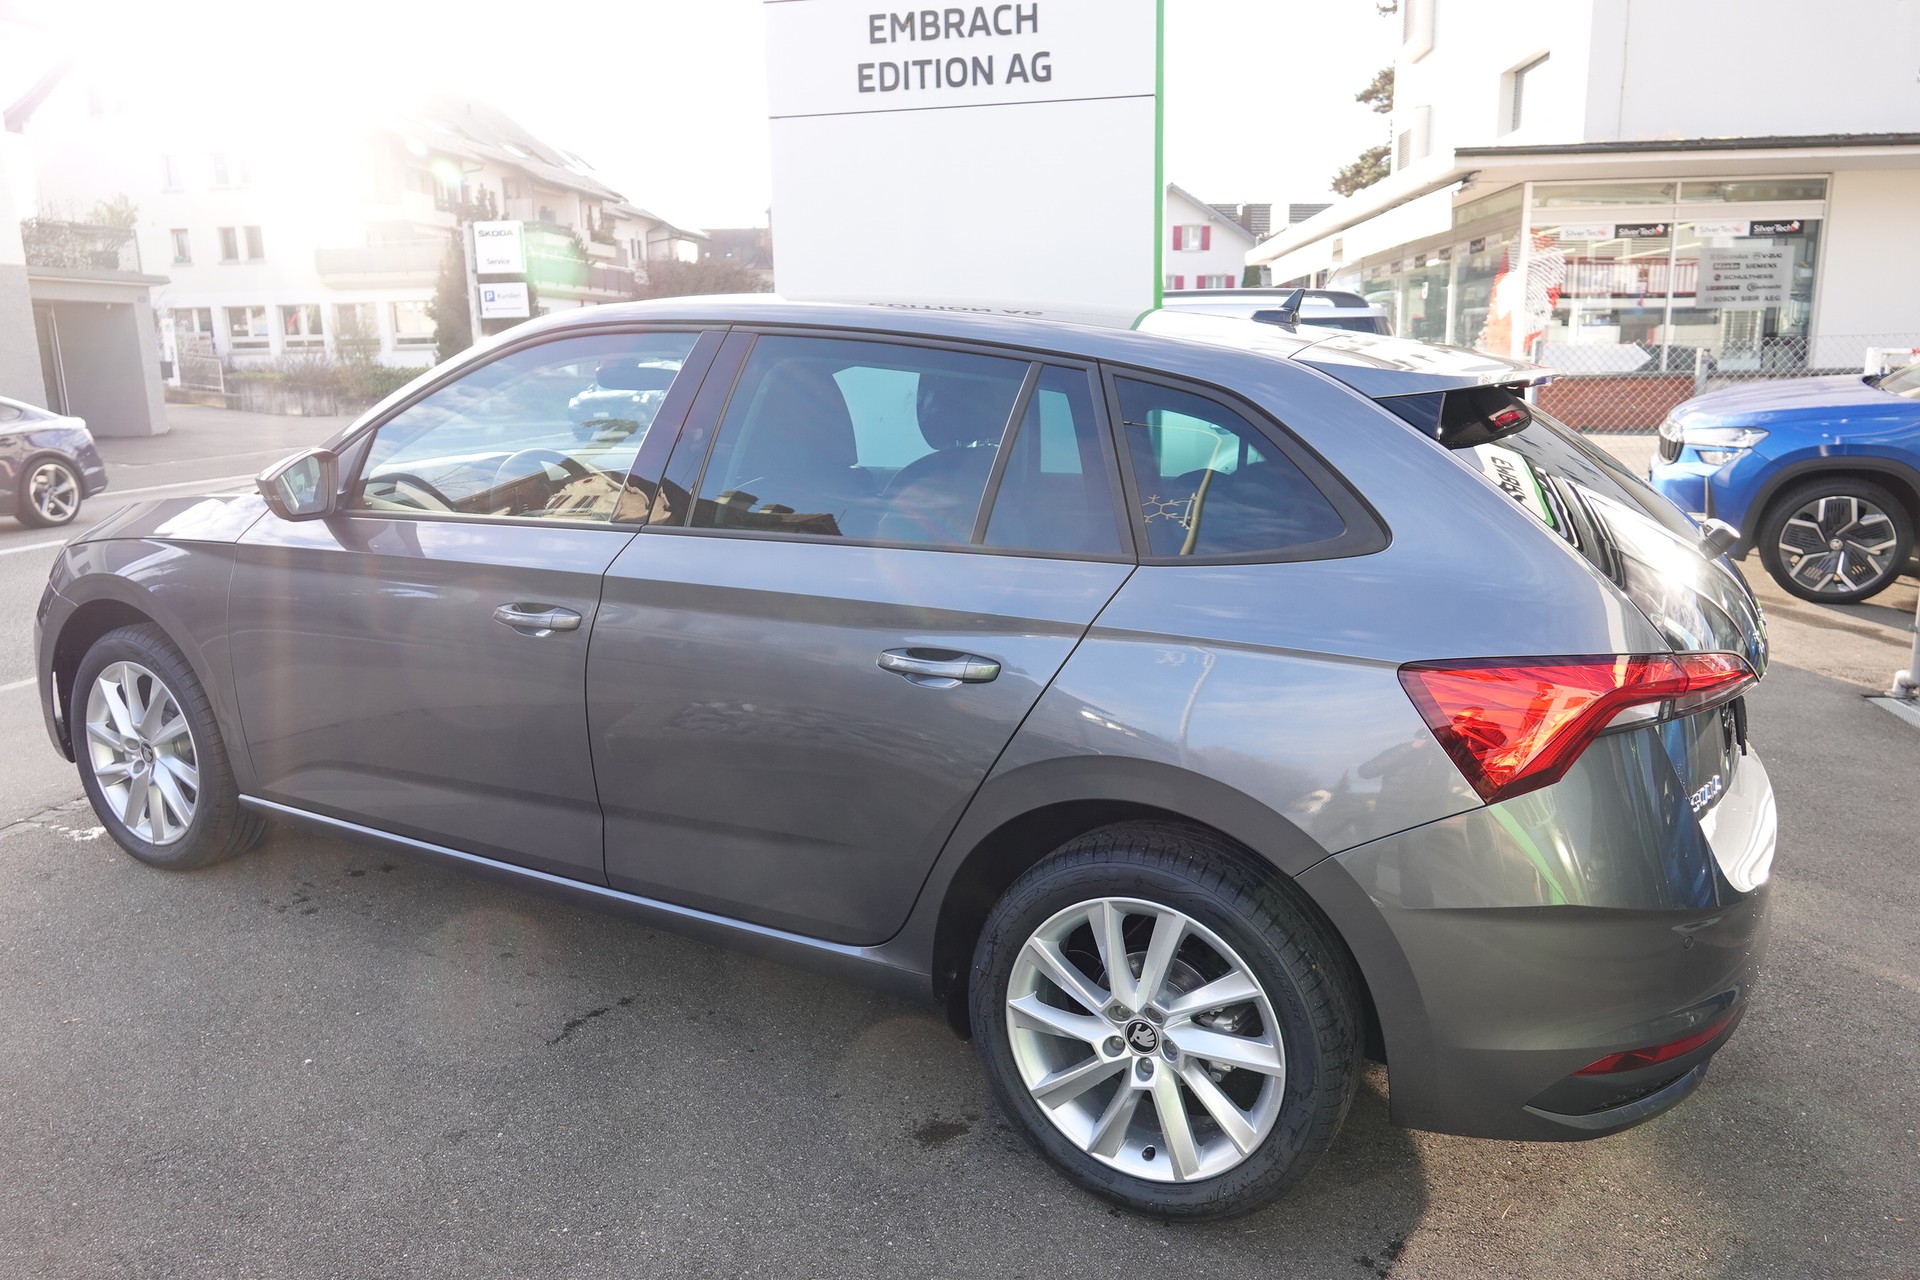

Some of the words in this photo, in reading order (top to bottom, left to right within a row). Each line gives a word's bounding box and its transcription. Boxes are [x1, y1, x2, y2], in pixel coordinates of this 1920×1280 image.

[869, 3, 1038, 44] EMBRACH
[857, 55, 994, 93] EDITION
[1005, 51, 1052, 84] AG
